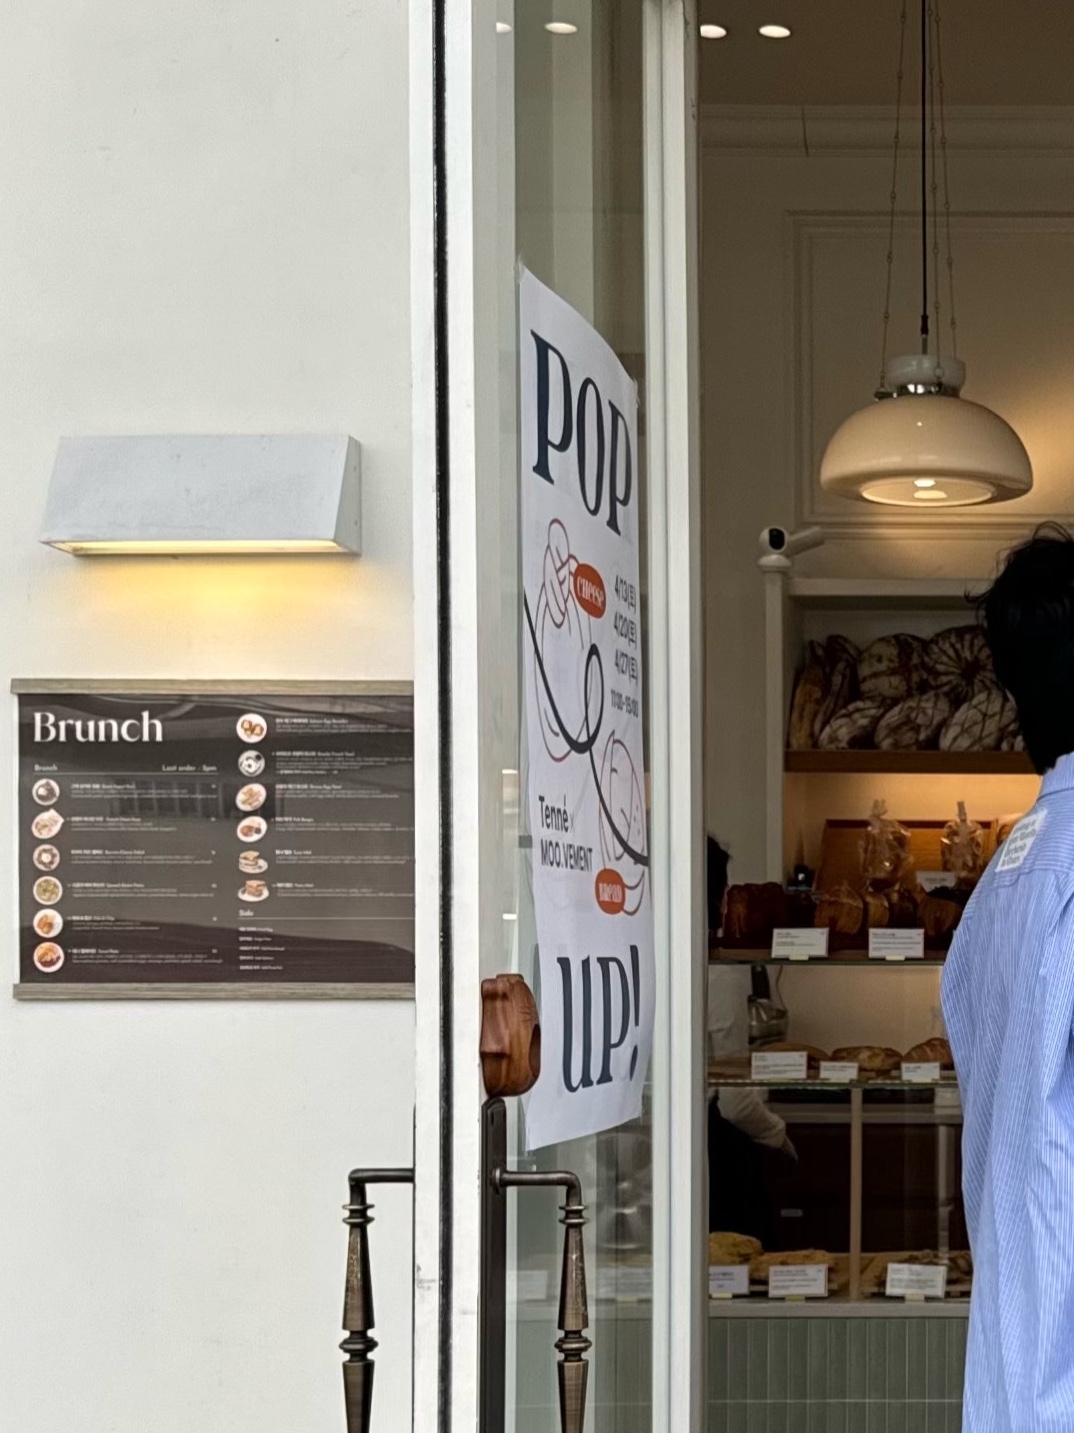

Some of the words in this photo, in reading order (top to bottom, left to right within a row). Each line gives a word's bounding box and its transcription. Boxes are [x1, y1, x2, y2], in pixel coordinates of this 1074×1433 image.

[530, 329, 633, 537] POP
[33, 710, 163, 742] Brunch
[538, 794, 569, 833] Tenné
[540, 839, 593, 872] MOO.VEMENT
[557, 944, 640, 1093] UP!
